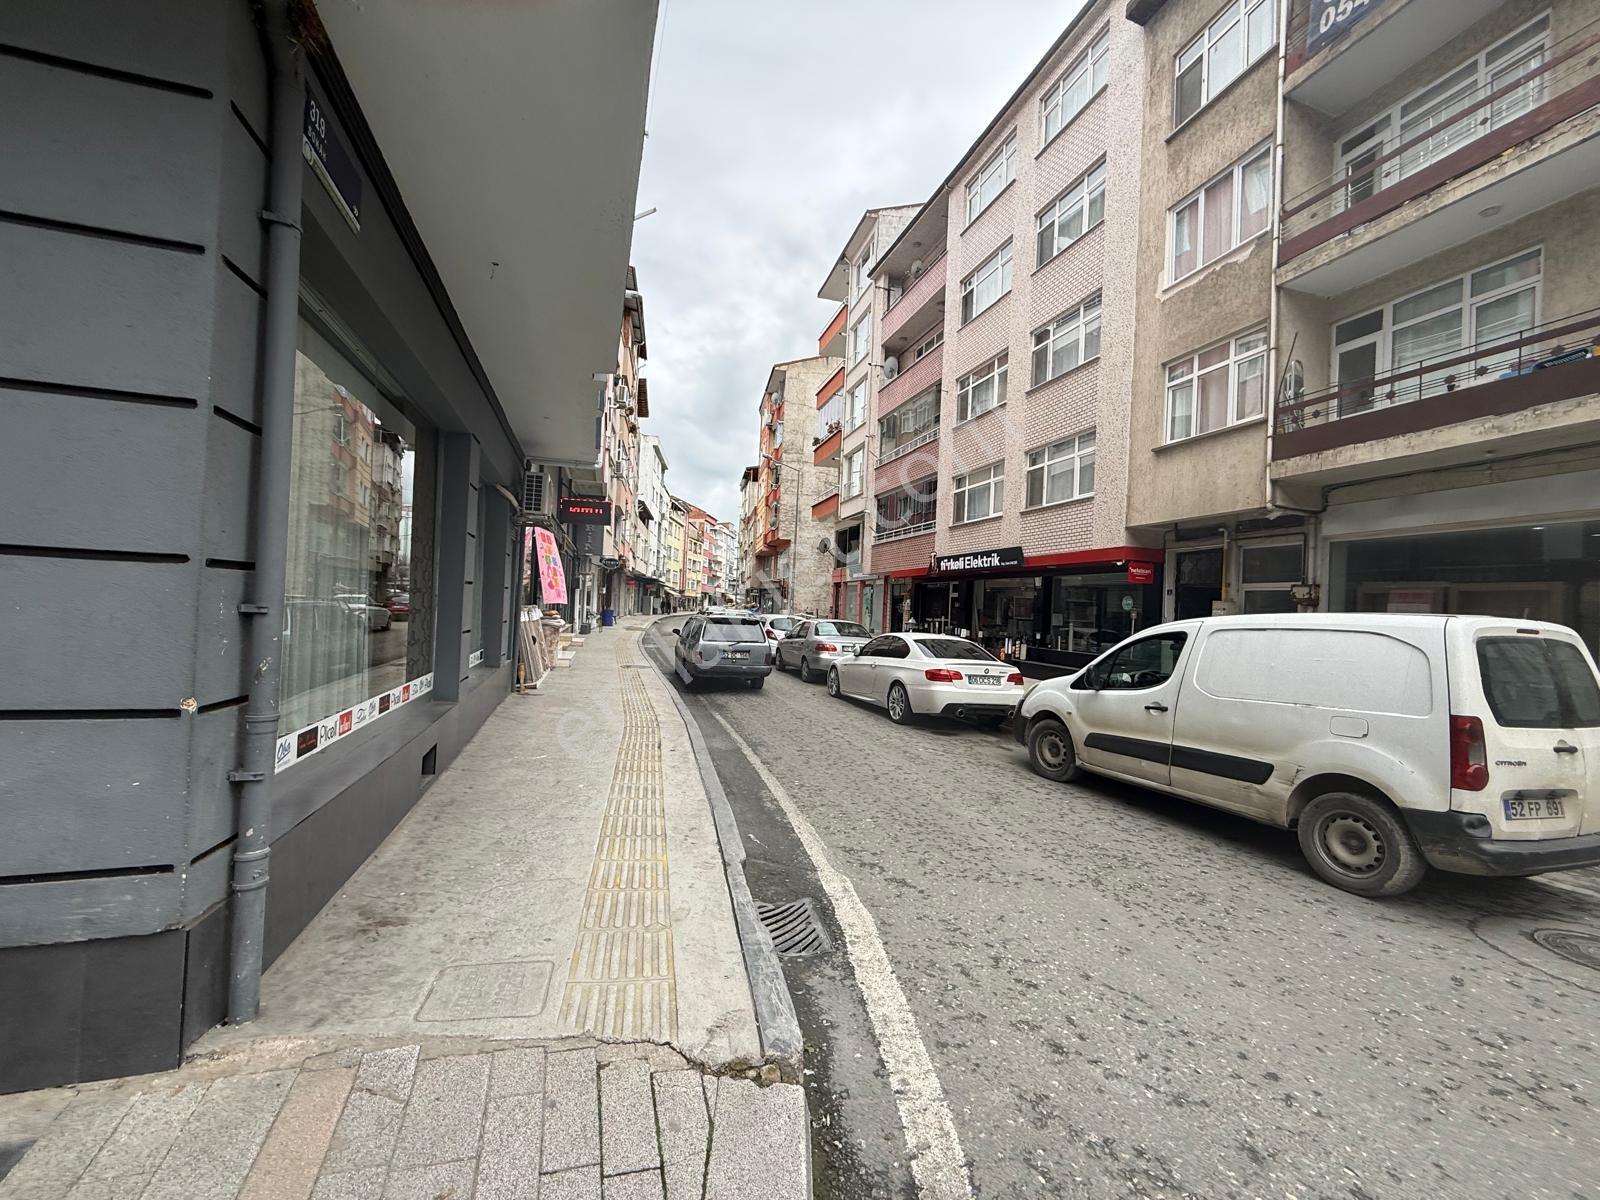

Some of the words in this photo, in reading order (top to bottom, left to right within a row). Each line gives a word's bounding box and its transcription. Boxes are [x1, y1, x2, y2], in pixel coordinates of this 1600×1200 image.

[964, 553, 1001, 569] Elektrik
[1510, 802, 1526, 817] 52
[1527, 802, 1541, 817] FP
[1546, 801, 1564, 816] 691
